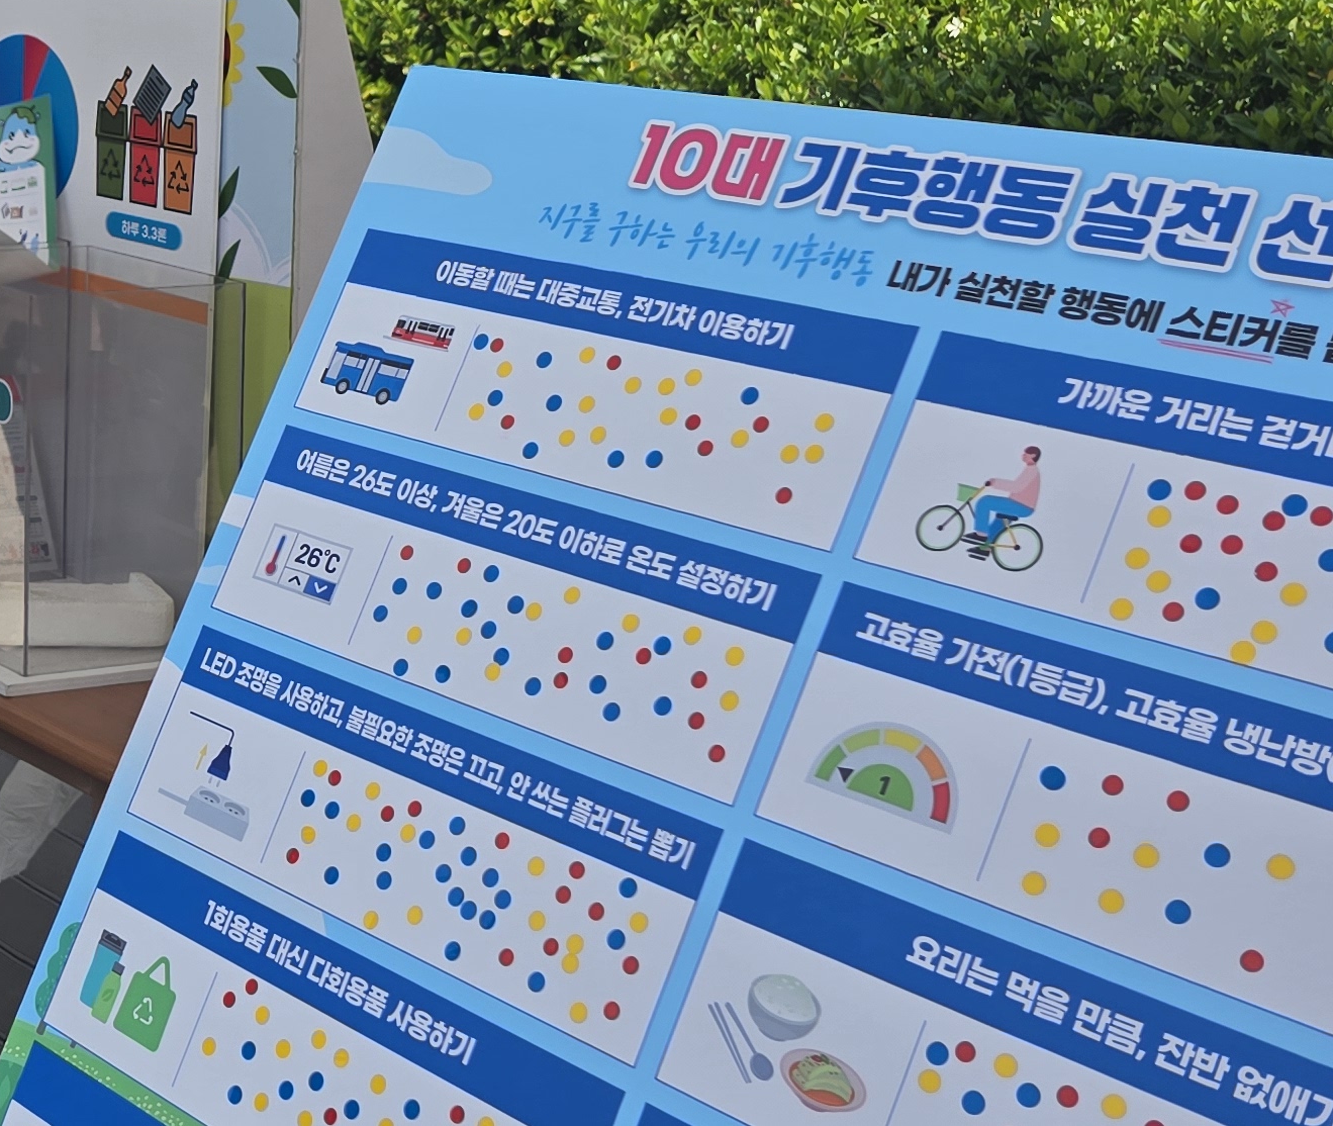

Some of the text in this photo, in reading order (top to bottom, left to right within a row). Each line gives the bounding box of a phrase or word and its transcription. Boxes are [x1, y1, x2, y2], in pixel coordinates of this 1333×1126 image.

[121, 219, 140, 238] 하루
[538, 201, 876, 288] 지구를 구하는 우리의 기후행동
[630, 122, 788, 203] 10대
[777, 140, 1077, 242] 기후행동
[1071, 176, 1253, 270] 실천
[435, 259, 796, 351] 이동할 때는 대중교통, 전기차 이용하기
[885, 260, 953, 298] 내가
[953, 270, 1057, 315] 실천할
[1057, 285, 1167, 335] 행동에
[1164, 304, 1320, 361] 스티커를
[1056, 377, 1333, 458] 가까운 거리는 걷거
[294, 448, 779, 614] 여름은 26도 이상, 겨울은 20도 이하로 온도 설정하기
[855, 610, 945, 662] 고효율
[944, 636, 1110, 716] 가전(1등급),
[1115, 687, 1220, 745] 고효율
[199, 647, 697, 871] LED 조명을 사용하고, 불필요한 조명은 끄고, 안 쓰는 플러그는 뽑기
[878, 774, 893, 796] 1
[202, 899, 478, 1067] 1회용품 대신 다회용품 사용하기
[904, 934, 1001, 998] 요리는
[1004, 970, 1072, 1026] 먹을
[1072, 997, 1147, 1061] 만큼,
[1153, 1030, 1232, 1092] 잔반
